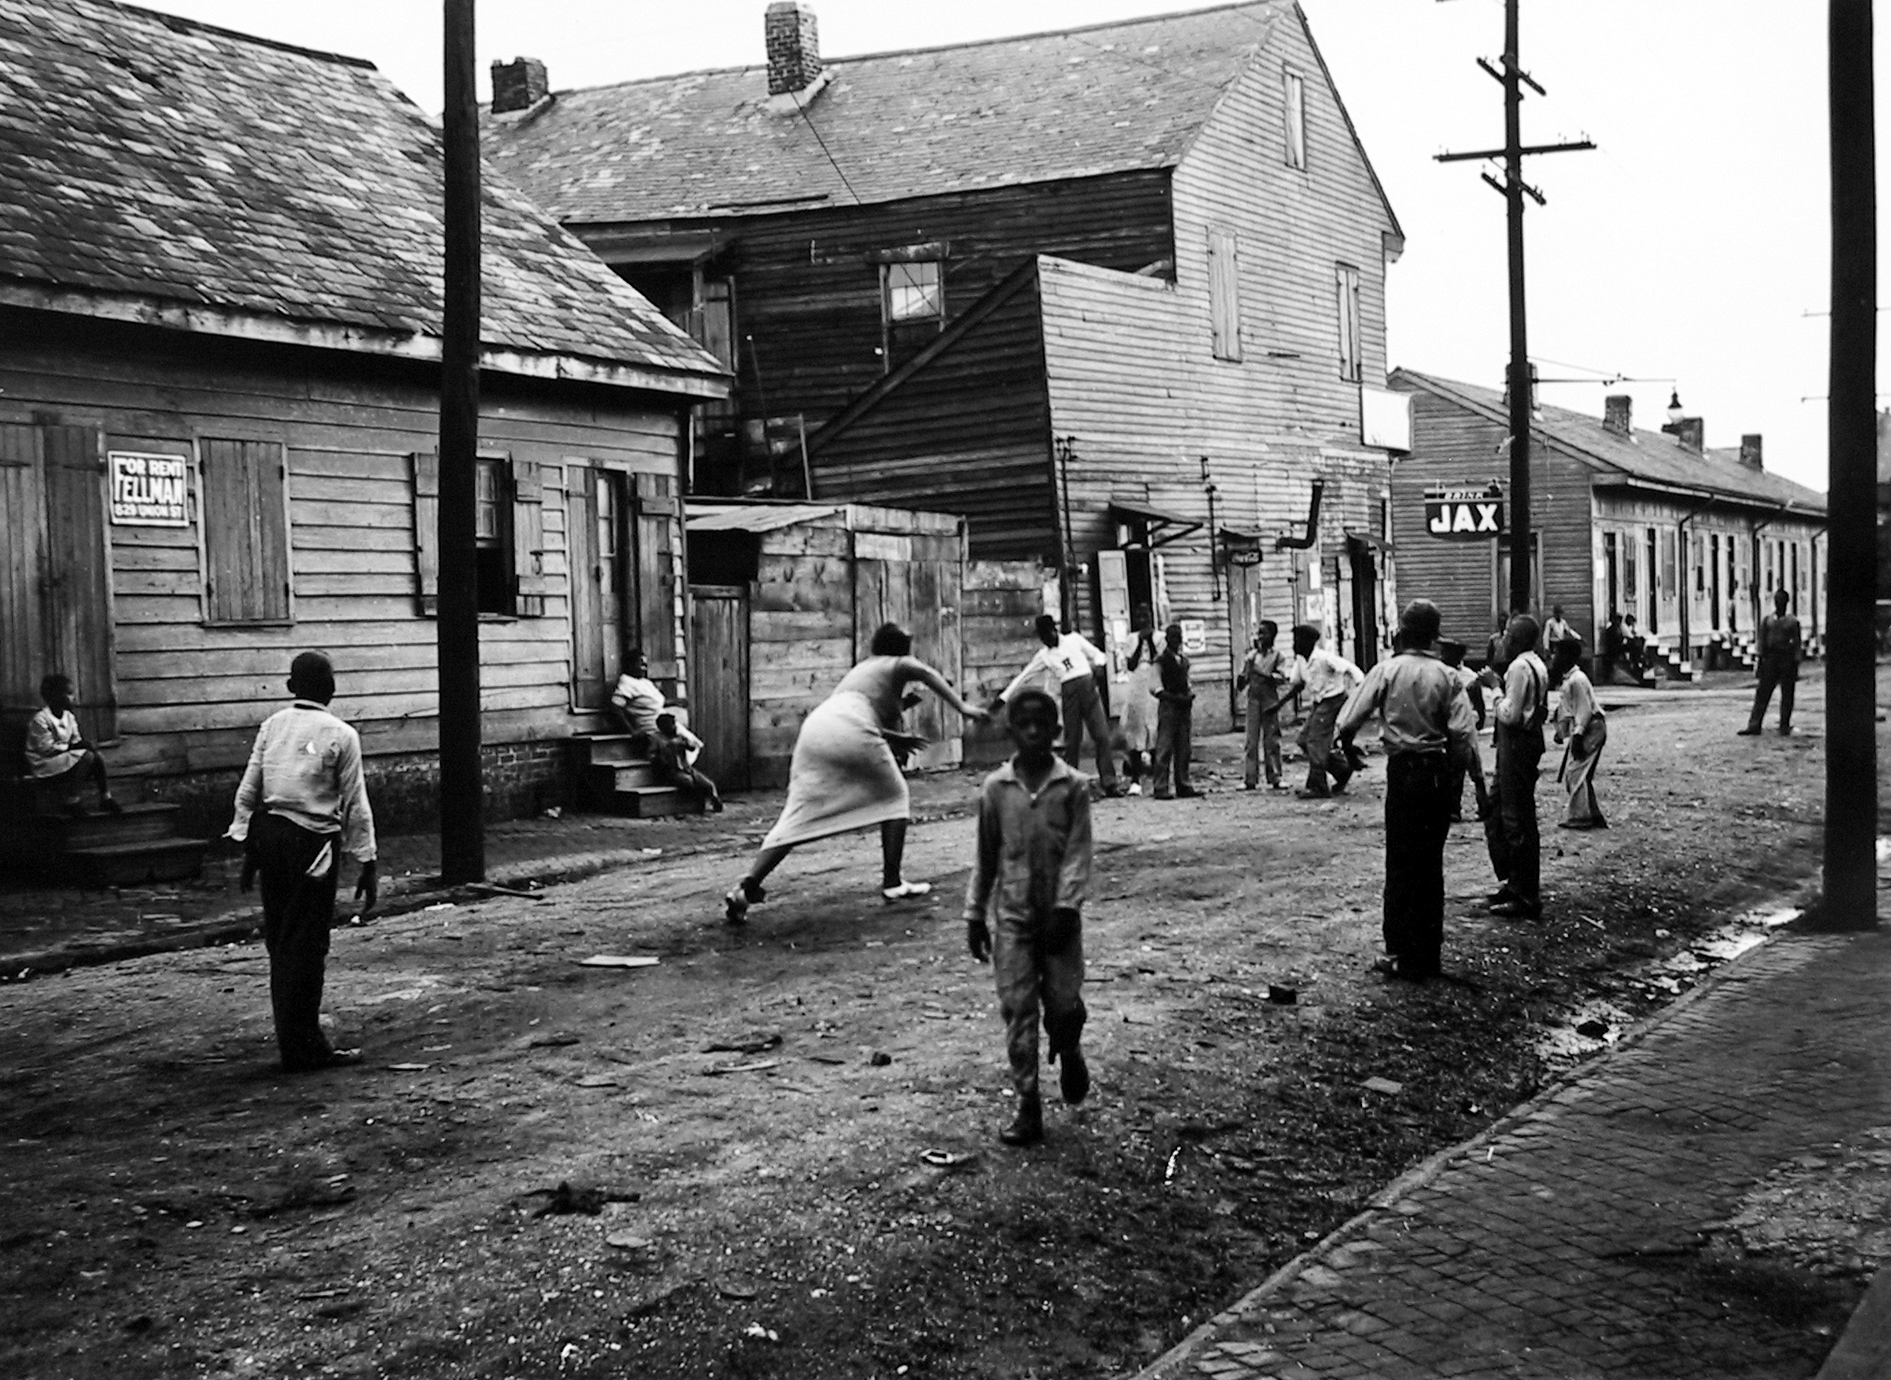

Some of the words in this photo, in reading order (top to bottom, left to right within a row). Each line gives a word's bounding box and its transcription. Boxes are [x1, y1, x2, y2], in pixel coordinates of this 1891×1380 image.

[113, 457, 146, 475] FOR
[148, 460, 182, 476] RENT
[114, 474, 183, 505] FELLMAN
[1430, 504, 1499, 534] JAX
